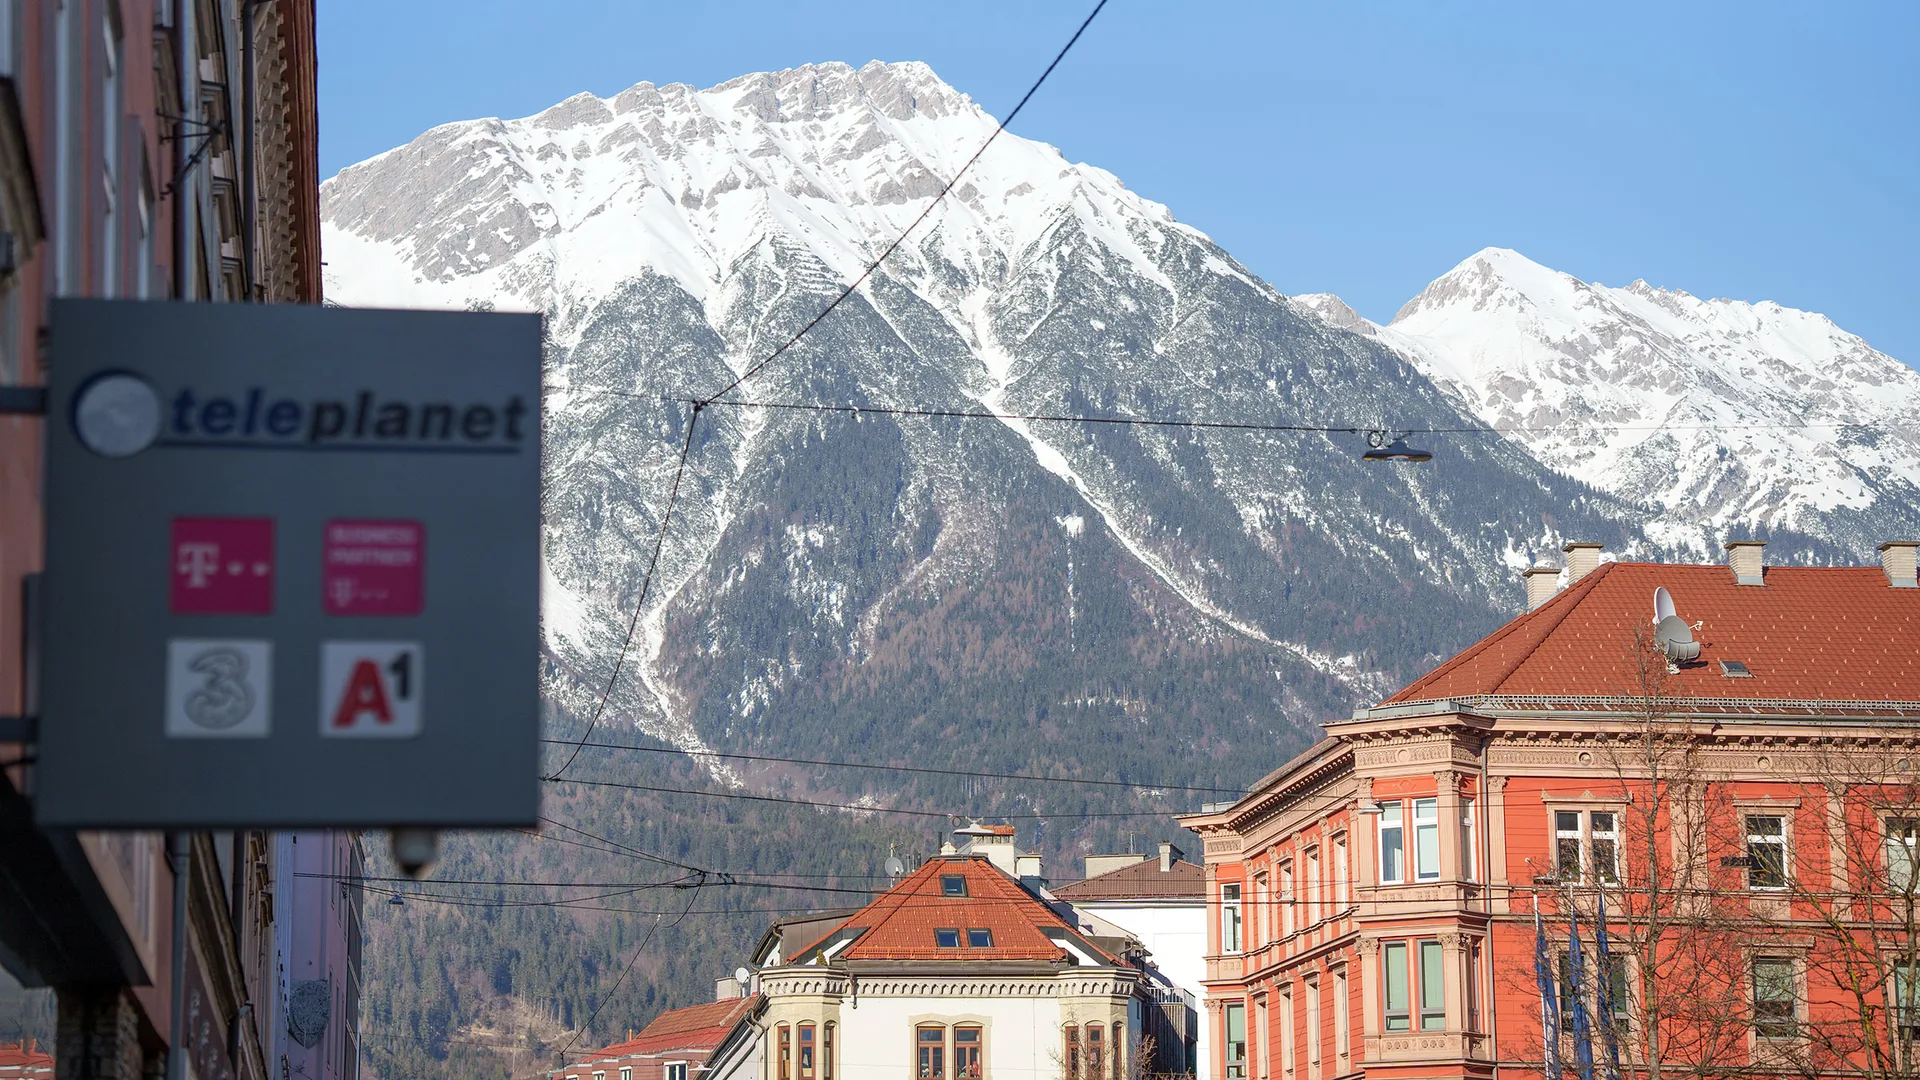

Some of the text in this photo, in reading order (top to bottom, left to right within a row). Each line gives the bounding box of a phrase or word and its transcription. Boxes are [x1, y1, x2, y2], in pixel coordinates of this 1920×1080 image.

[170, 386, 529, 442] teleplanet
[183, 648, 256, 730] 3
[332, 651, 412, 729] A1
